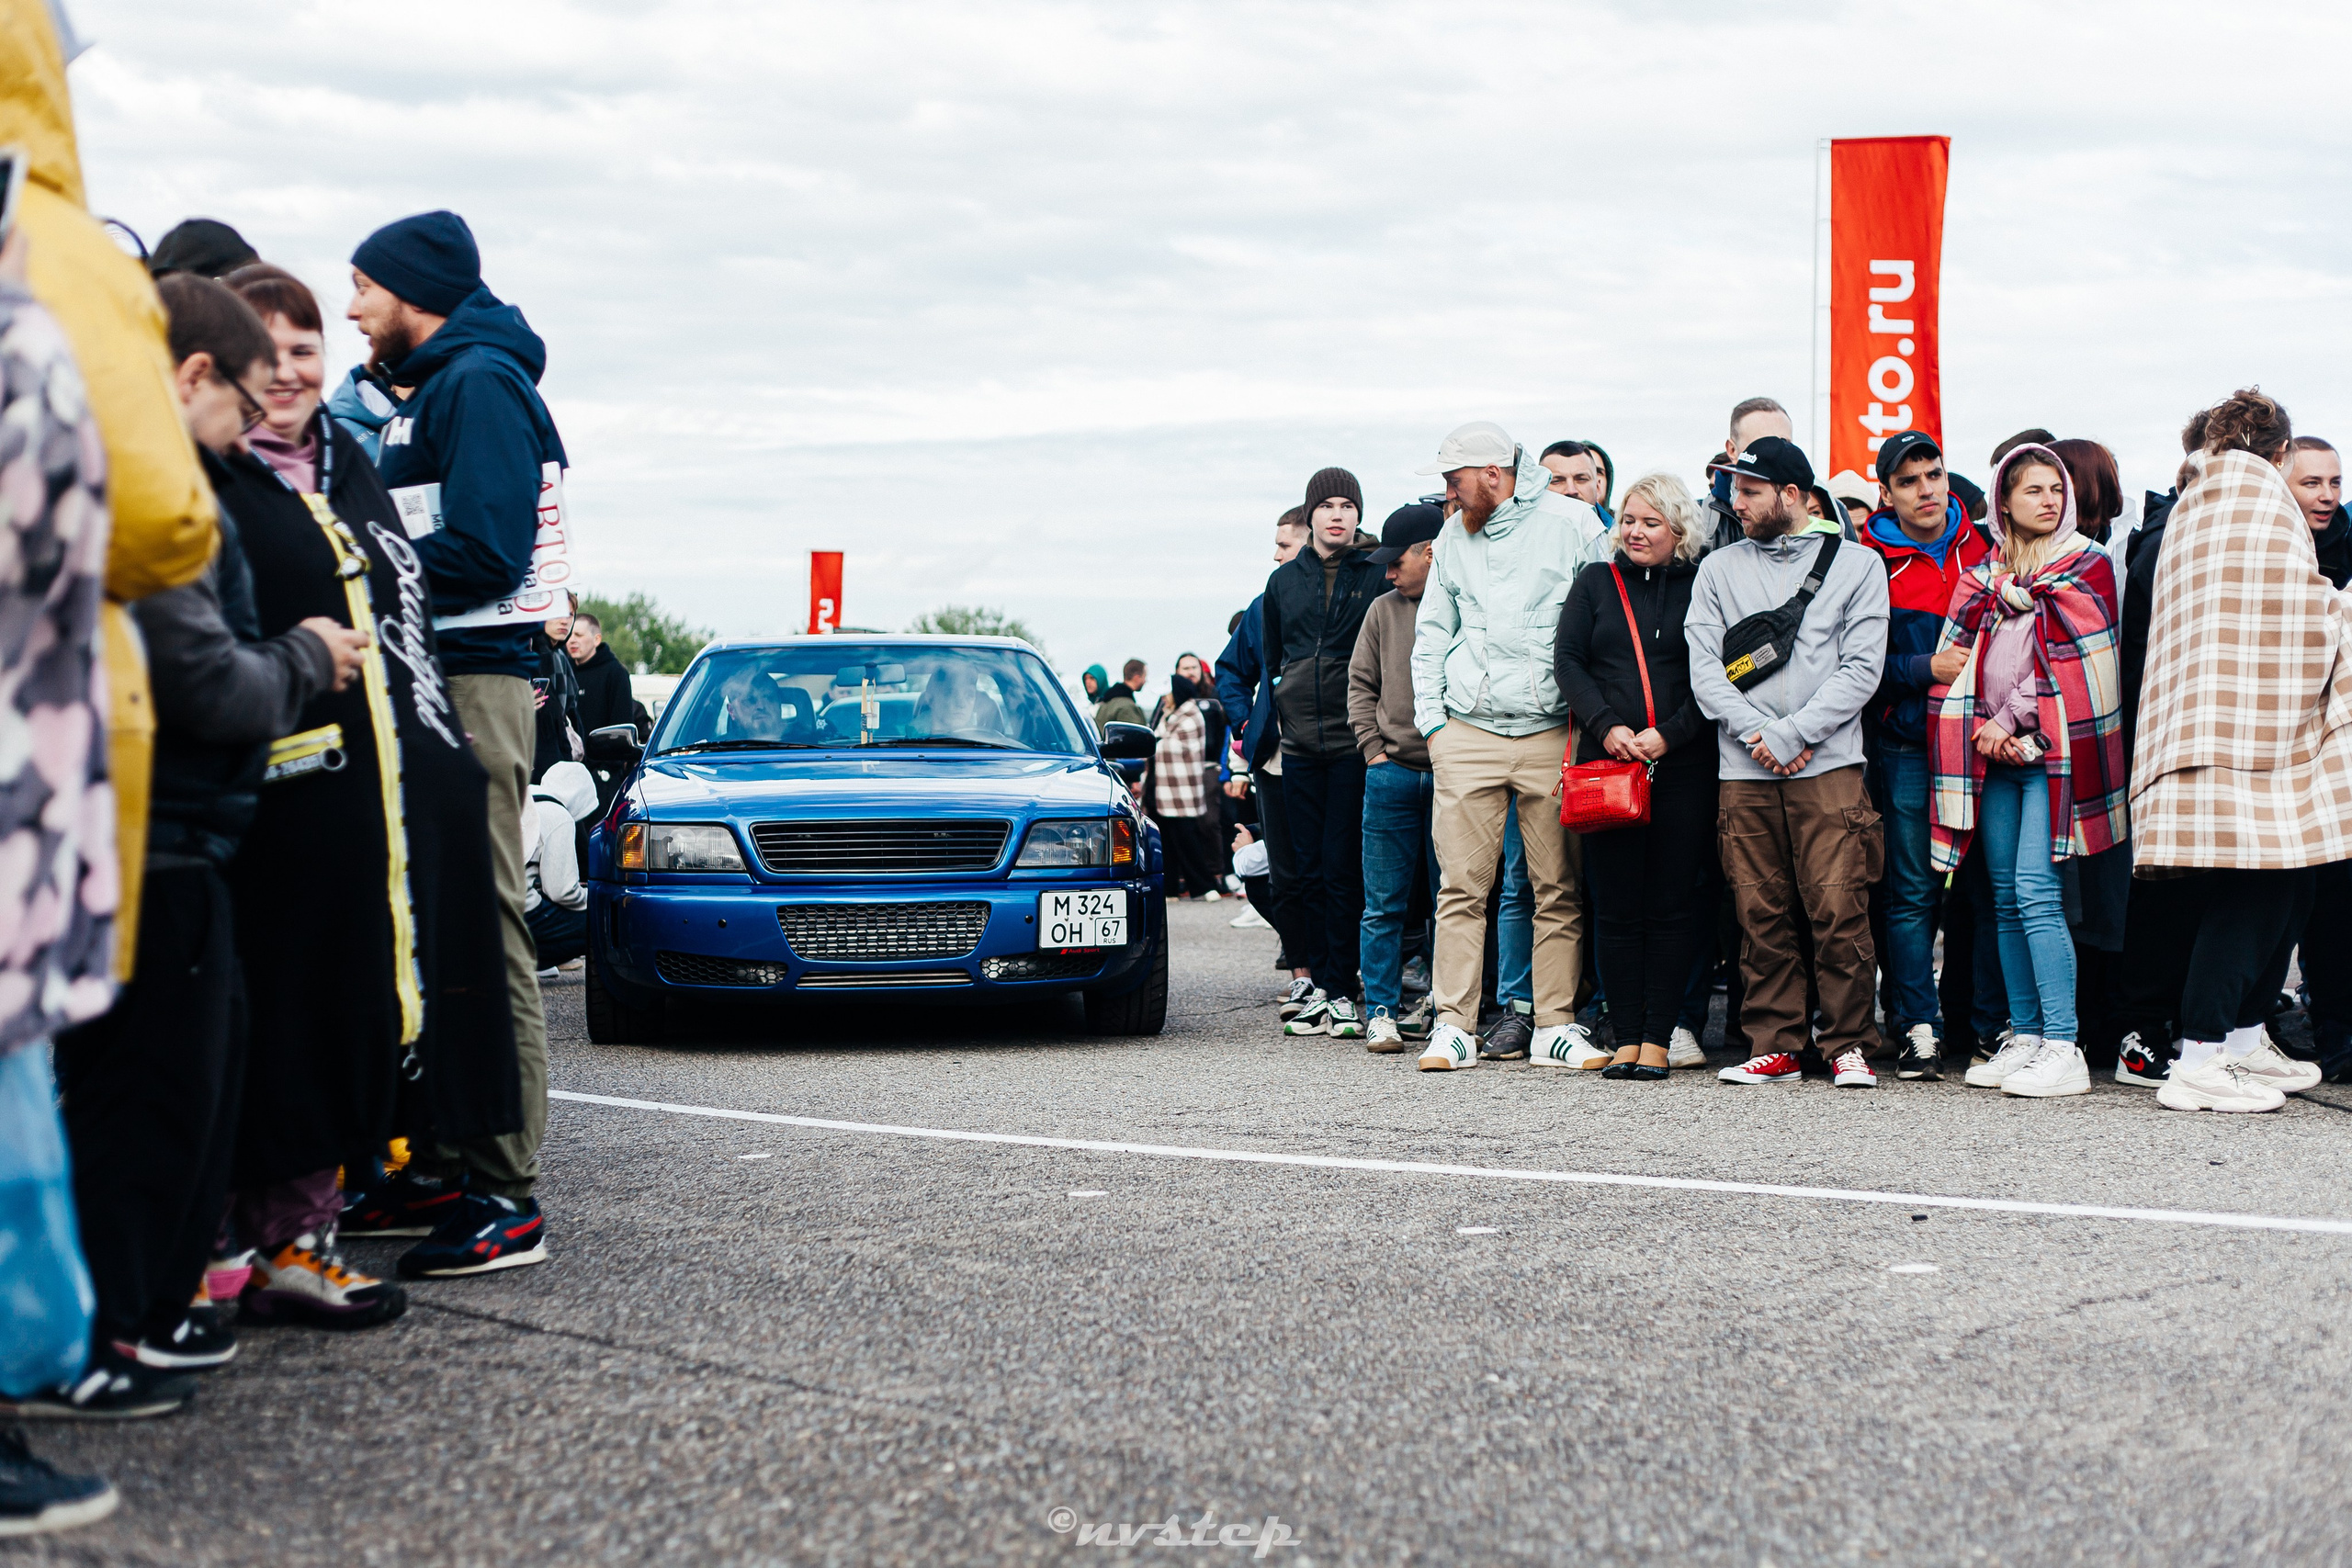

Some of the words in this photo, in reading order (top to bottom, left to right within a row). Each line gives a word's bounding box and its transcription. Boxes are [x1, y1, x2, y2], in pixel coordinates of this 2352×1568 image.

[1858, 259, 1916, 479] to.ru
[1054, 896, 1070, 917] М
[1078, 894, 1114, 916] 324
[1051, 922, 1082, 943] ОН
[1102, 920, 1120, 937] 67
